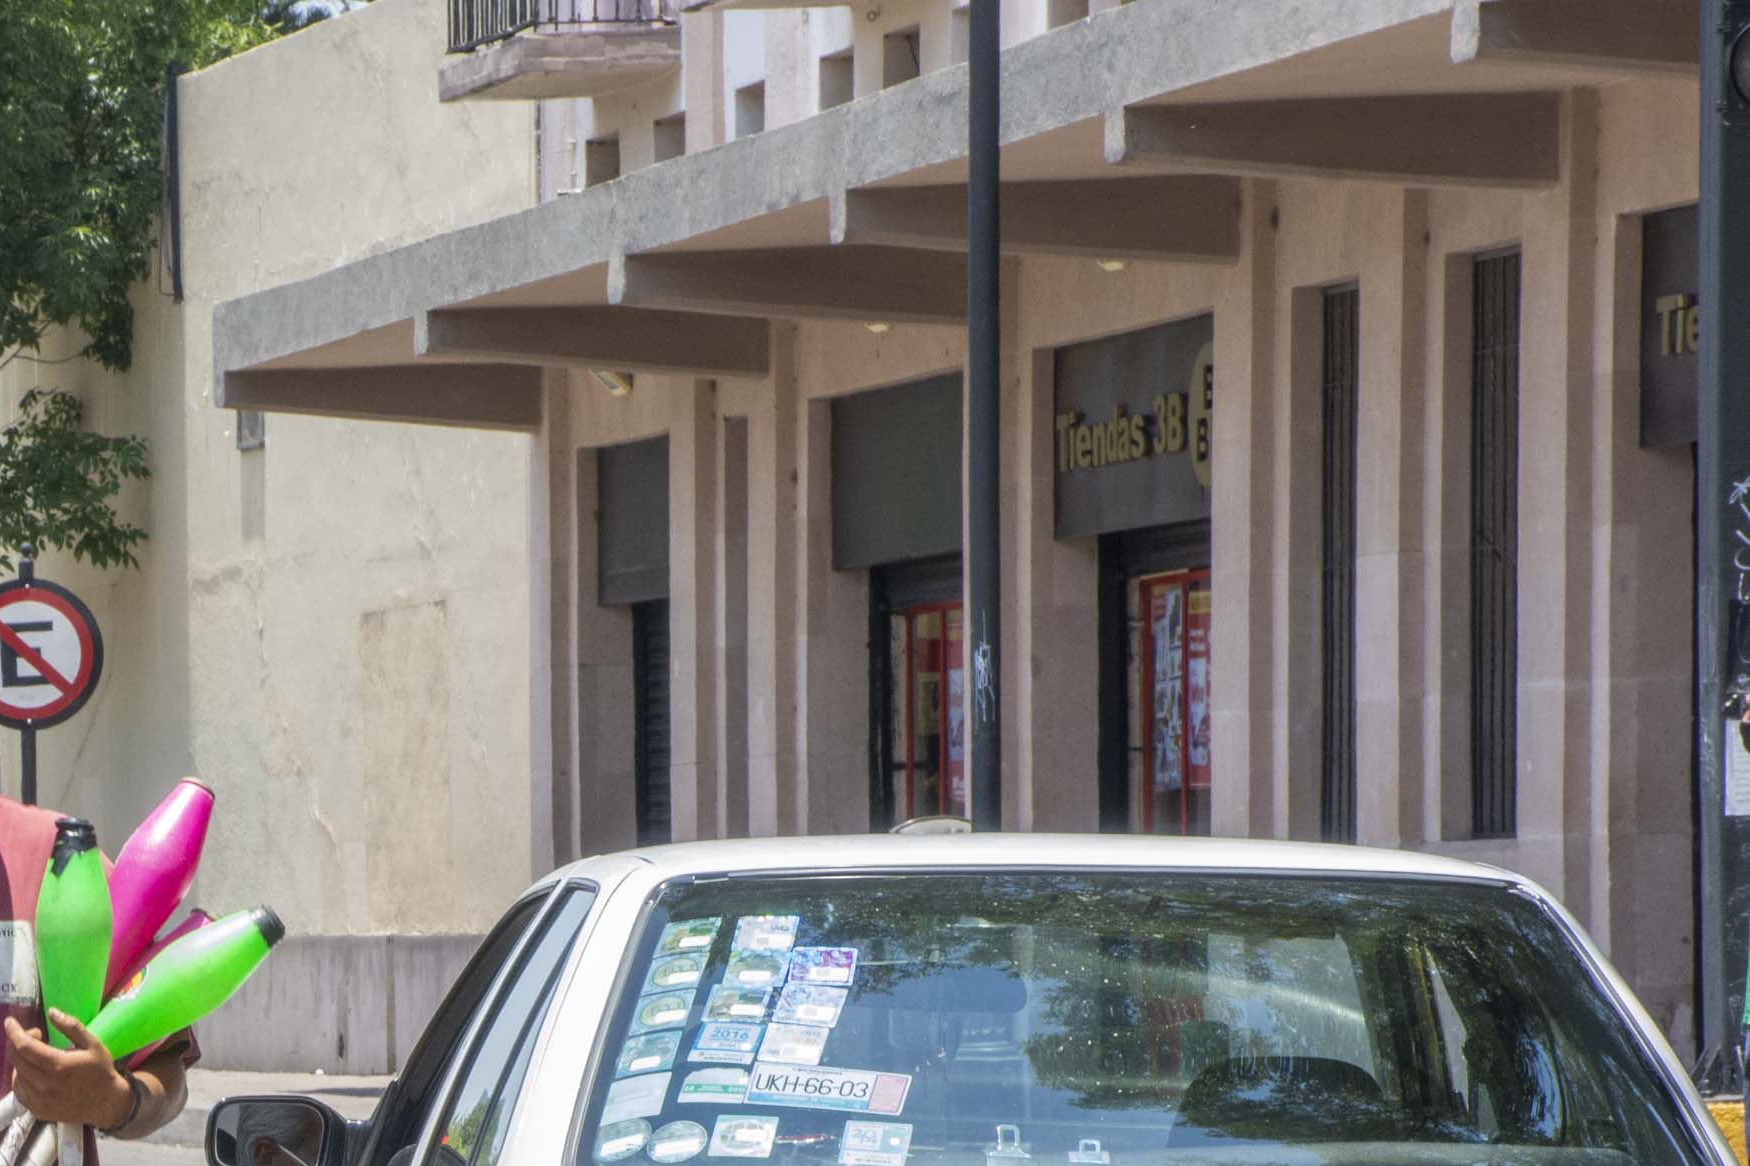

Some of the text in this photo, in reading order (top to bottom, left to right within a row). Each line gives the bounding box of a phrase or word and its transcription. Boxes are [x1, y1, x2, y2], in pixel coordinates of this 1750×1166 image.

[1056, 393, 1183, 472] Tiendas 3B
[755, 1073, 870, 1098] UKH-66-03
